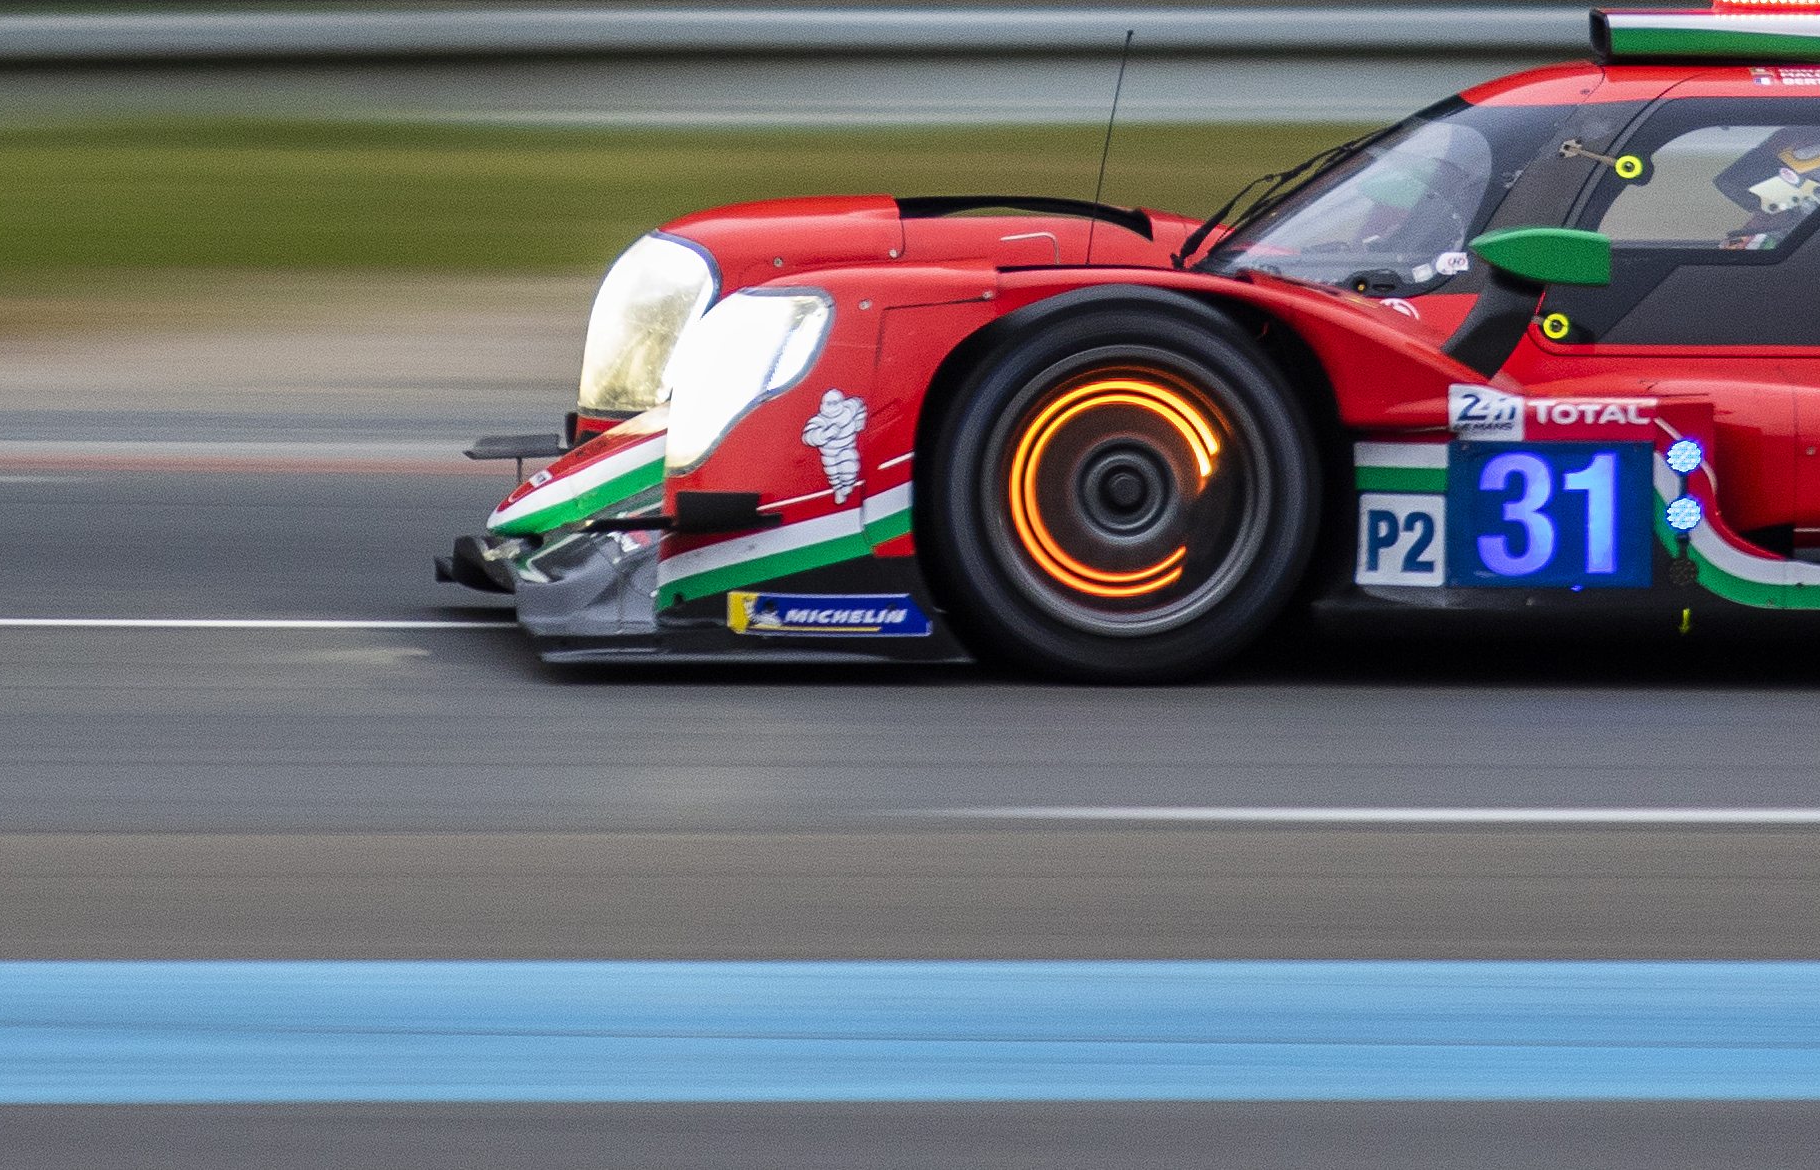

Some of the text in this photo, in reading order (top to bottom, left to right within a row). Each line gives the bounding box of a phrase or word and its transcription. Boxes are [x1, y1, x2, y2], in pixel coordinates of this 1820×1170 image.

[1529, 399, 1652, 425] TOTAL
[1472, 422, 1514, 431] MANS
[1477, 451, 1619, 577] 31
[1366, 509, 1435, 573] P2
[783, 608, 909, 624] MICHELIN
